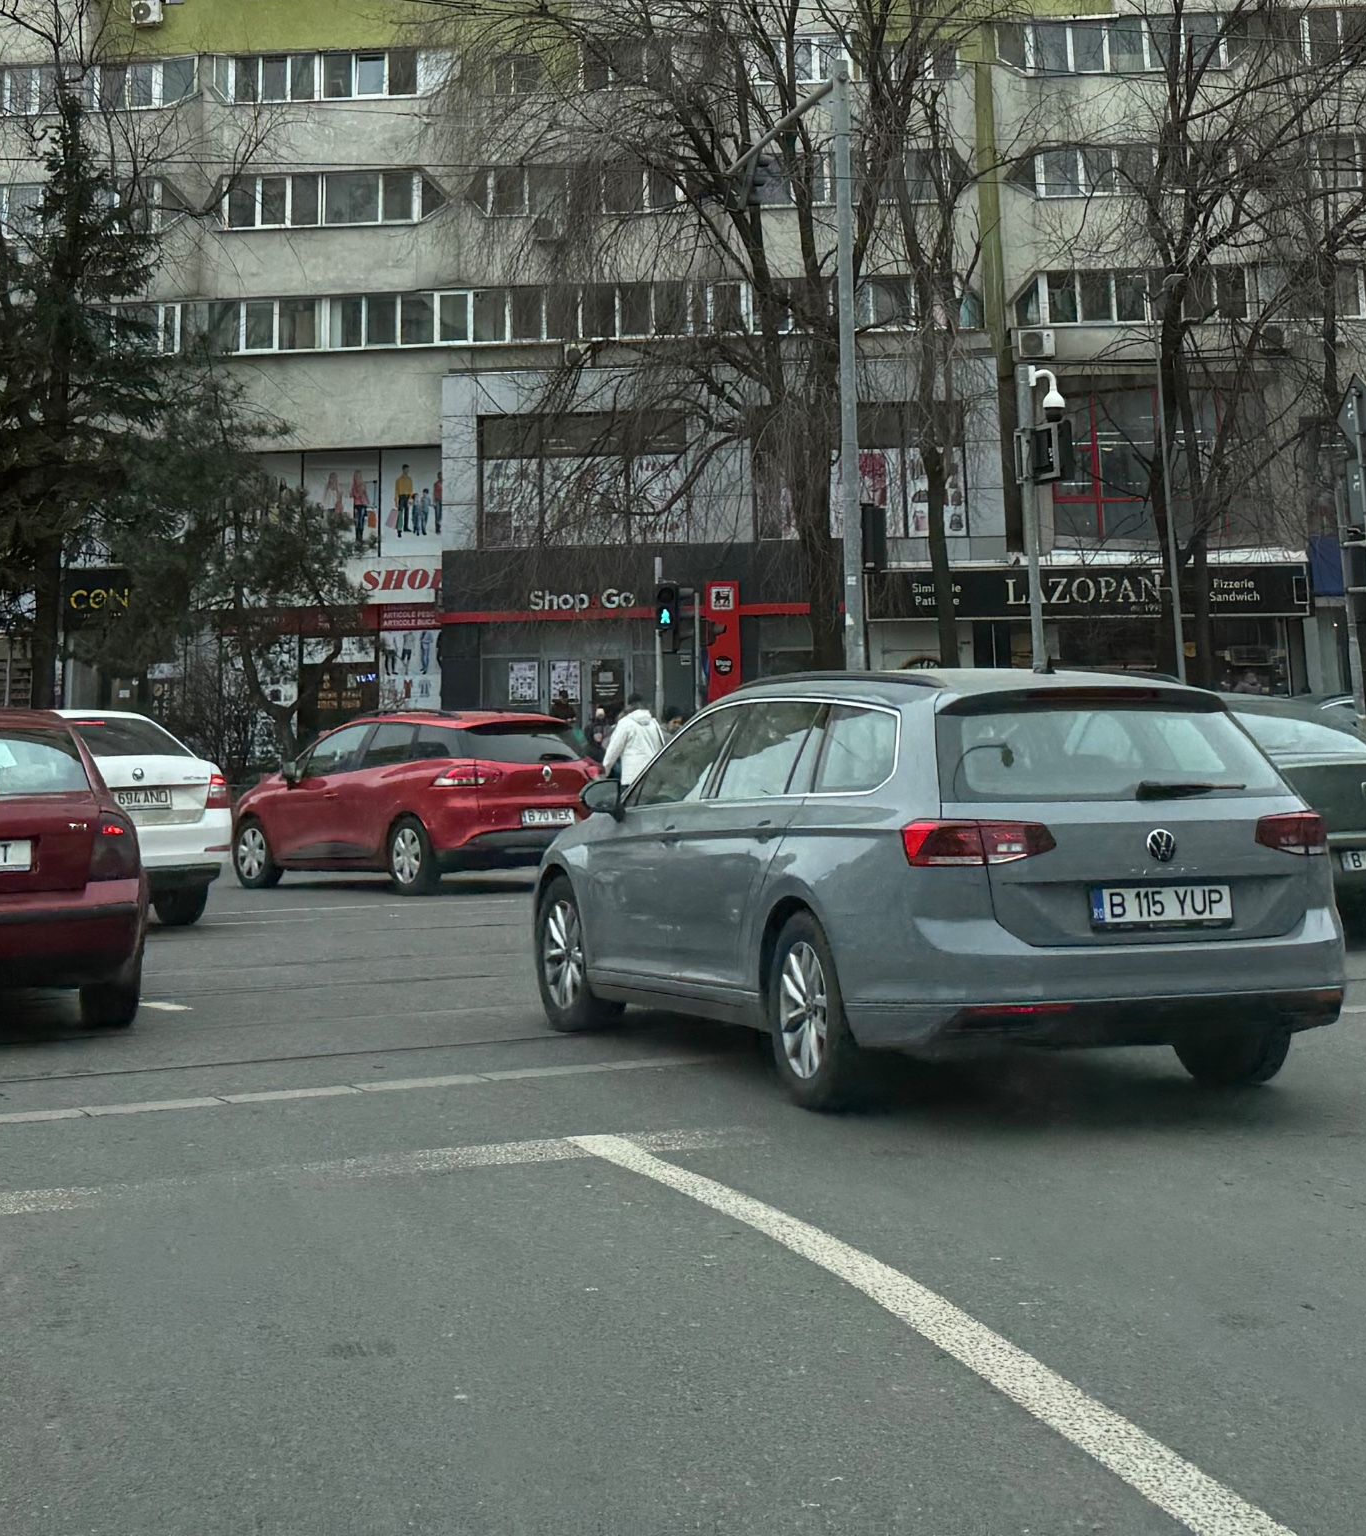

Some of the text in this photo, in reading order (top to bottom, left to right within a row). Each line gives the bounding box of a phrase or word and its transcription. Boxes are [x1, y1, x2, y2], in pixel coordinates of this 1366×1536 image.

[1212, 578, 1255, 589] Pizzerie
[1209, 591, 1261, 602] Sandwich
[117, 791, 142, 806] 694
[538, 810, 549, 821] 70
[1351, 852, 1362, 868] B
[1109, 888, 1223, 919] B 115 YUP
